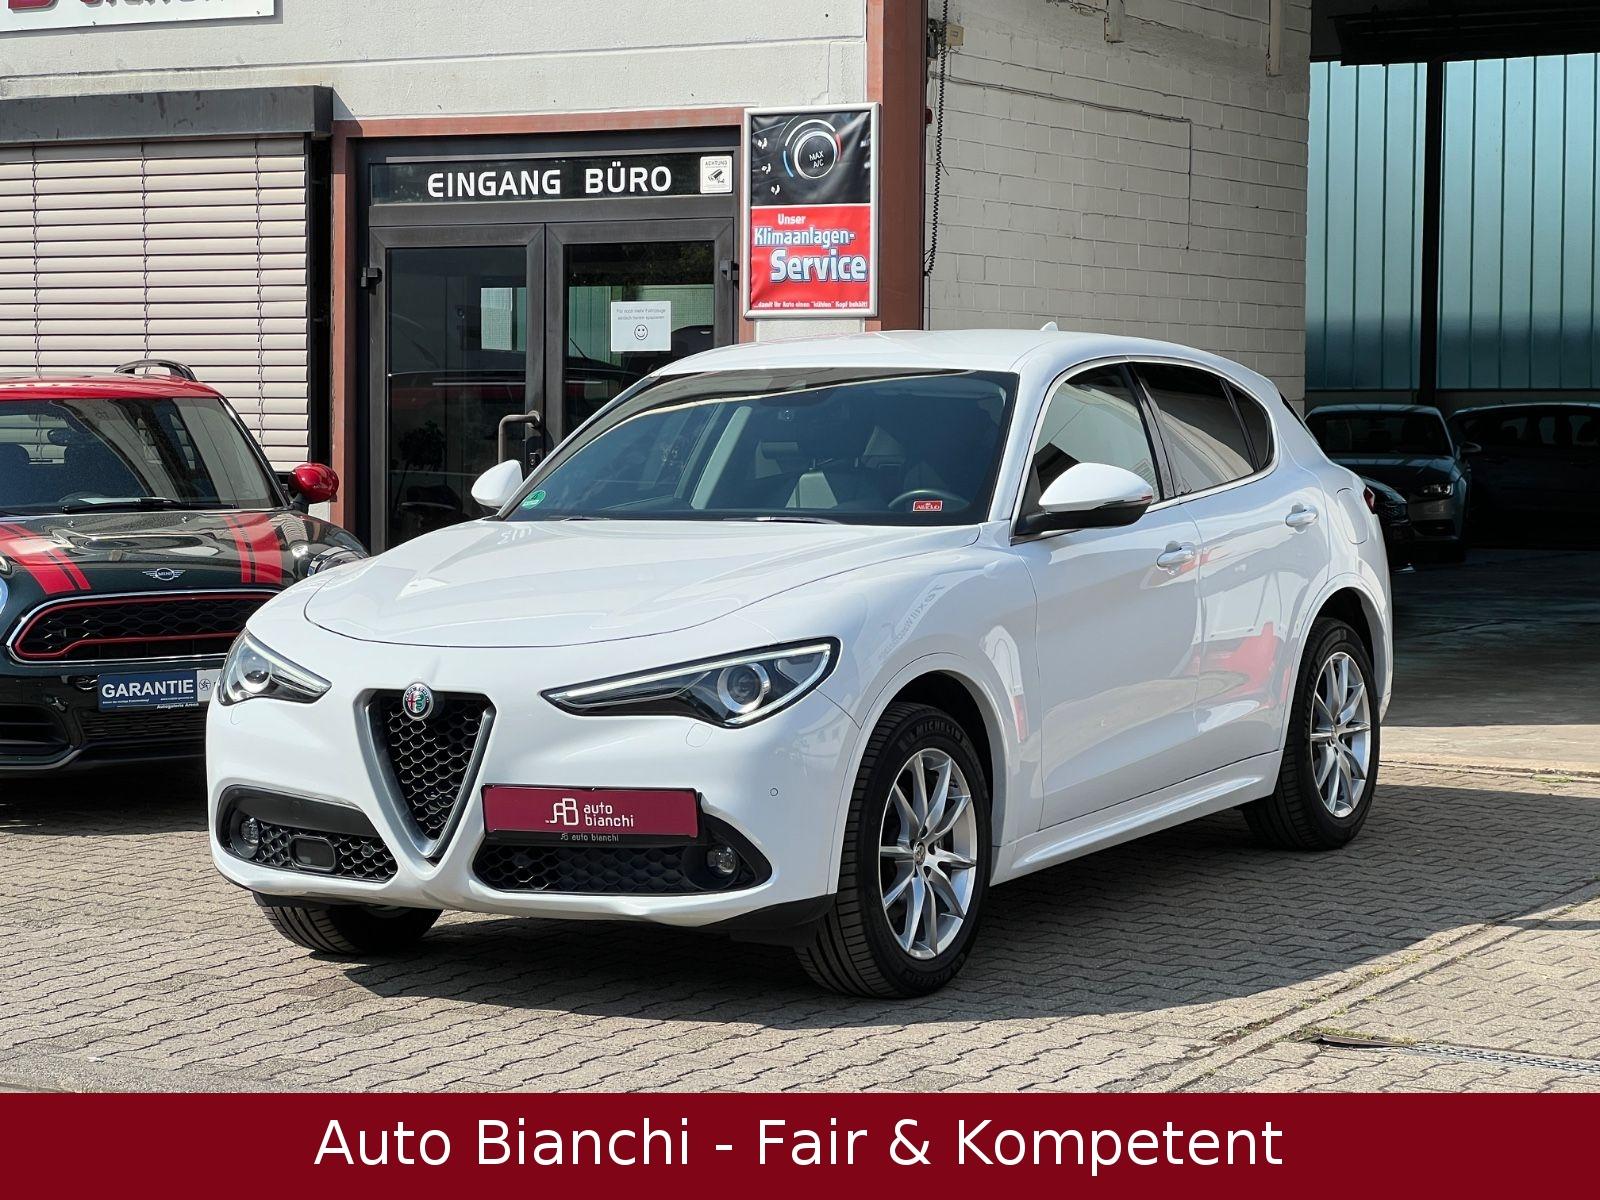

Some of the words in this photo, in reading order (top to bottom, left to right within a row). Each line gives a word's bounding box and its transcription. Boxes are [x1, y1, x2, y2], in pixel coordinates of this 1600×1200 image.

[809, 150, 825, 162] MAX
[812, 161, 824, 169] A/C
[427, 169, 561, 198] EINGANG
[585, 161, 672, 194] BÜRO
[777, 213, 806, 225] Unser
[754, 226, 856, 248] Klimaanlagen-
[770, 248, 867, 282] Service
[101, 680, 194, 698] GARANTIE
[916, 720, 961, 740] MICHELIN
[583, 802, 613, 814] auto
[585, 814, 634, 827] bianchi
[571, 833, 589, 841] auto
[591, 833, 619, 842] bianchi
